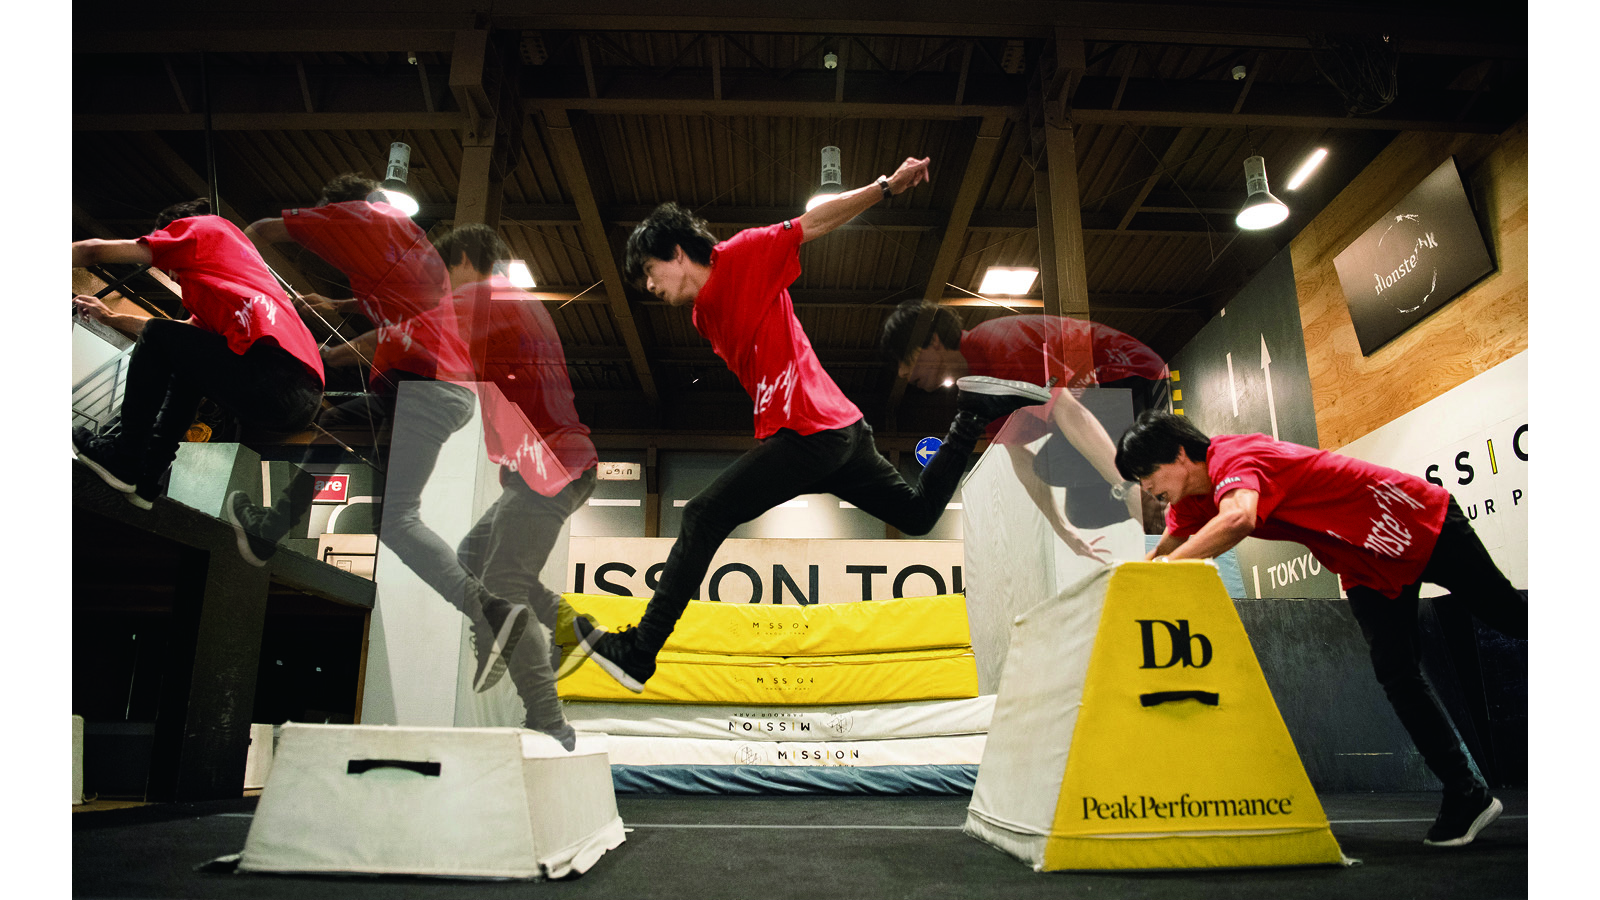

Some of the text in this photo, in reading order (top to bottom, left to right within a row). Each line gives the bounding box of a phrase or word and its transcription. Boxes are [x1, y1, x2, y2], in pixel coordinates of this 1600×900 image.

[1267, 552, 1321, 589] TOKYO
[1134, 619, 1213, 669] Db
[778, 749, 859, 760] MISSION
